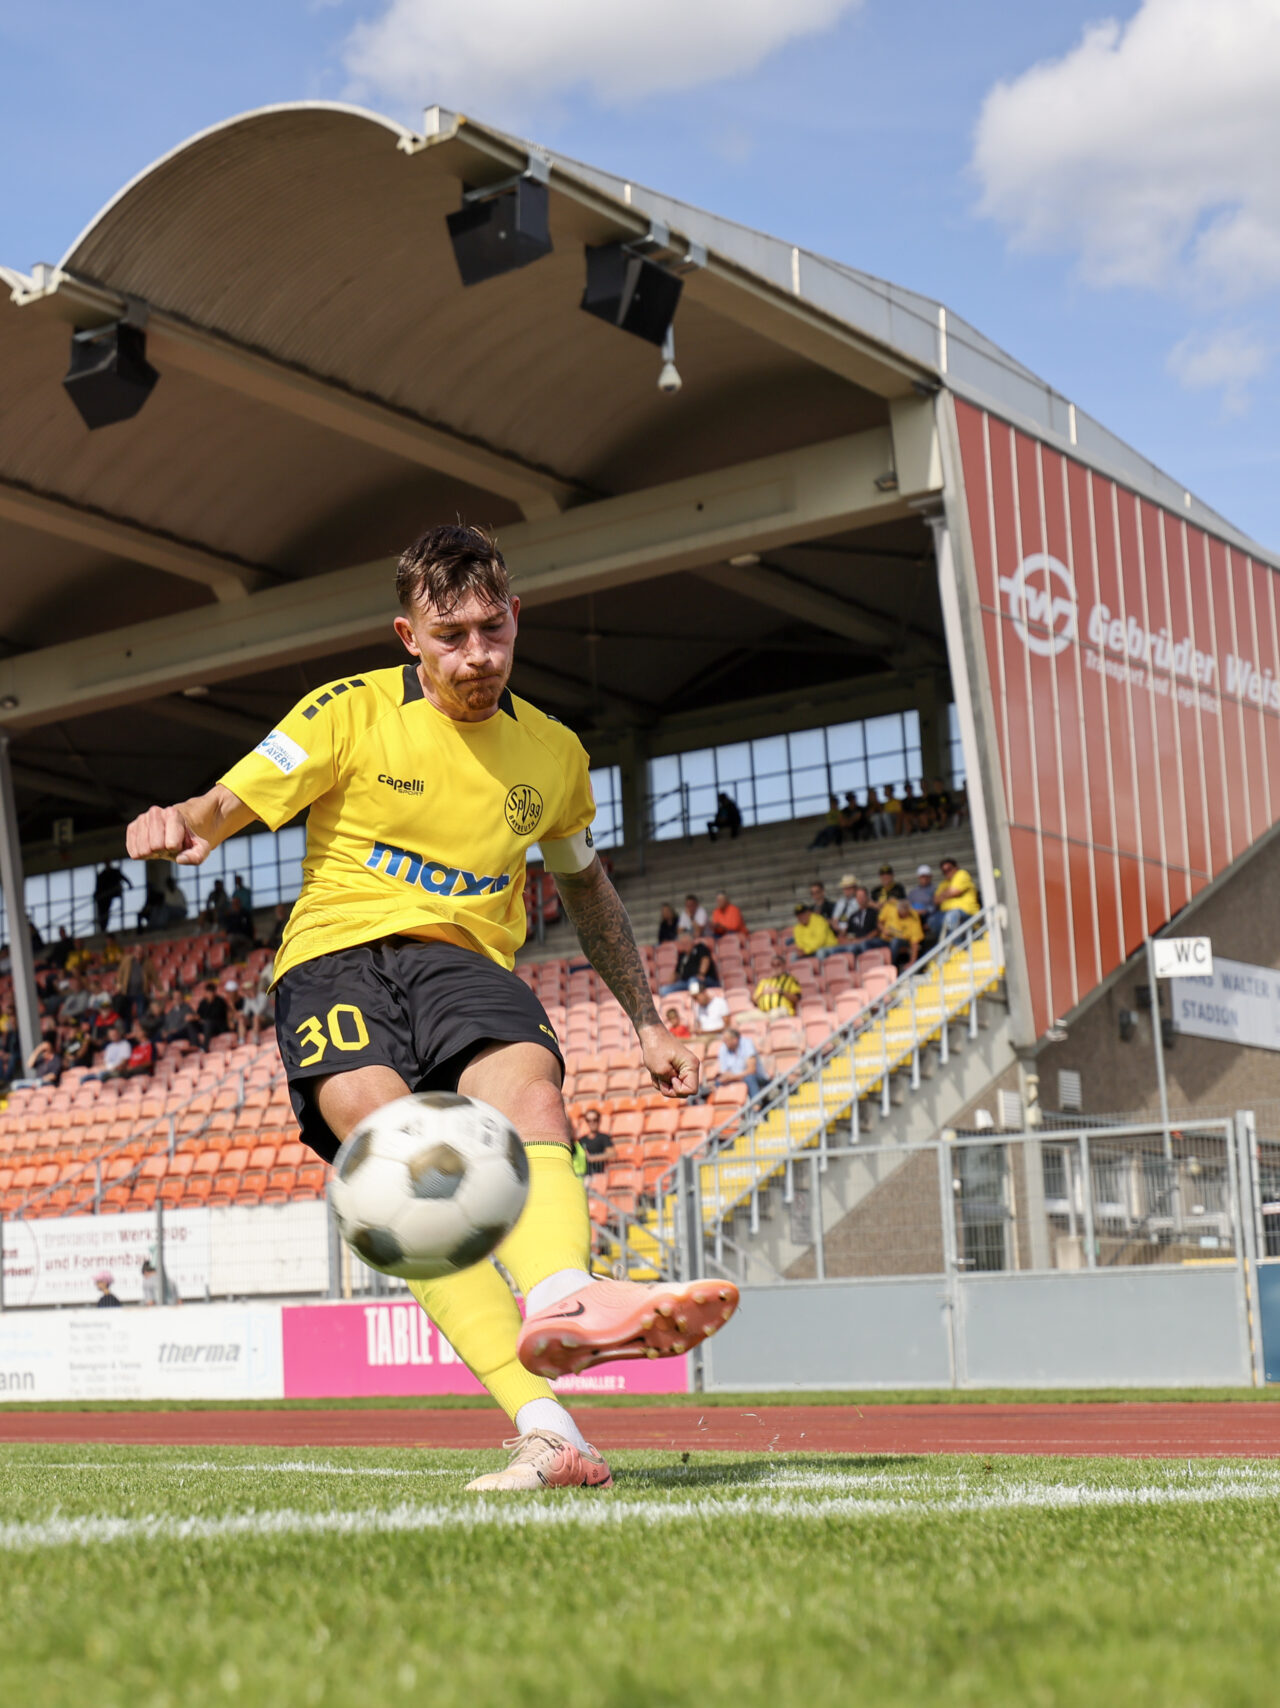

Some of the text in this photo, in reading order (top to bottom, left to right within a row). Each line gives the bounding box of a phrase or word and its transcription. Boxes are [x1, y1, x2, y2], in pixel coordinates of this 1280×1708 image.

[1087, 602, 1216, 685] Gebrüder
[265, 747, 294, 771] AYERN
[377, 773, 425, 792] capelli
[398, 789, 424, 797] SPORT
[508, 815, 535, 833] BAYREUTH
[1174, 942, 1206, 963] WC
[1222, 973, 1270, 998] WALTER
[1182, 999, 1239, 1026] STADION
[295, 1003, 370, 1068] 30
[45, 1255, 69, 1271] und
[364, 1306, 433, 1366] TABLE
[158, 1342, 241, 1363] therma
